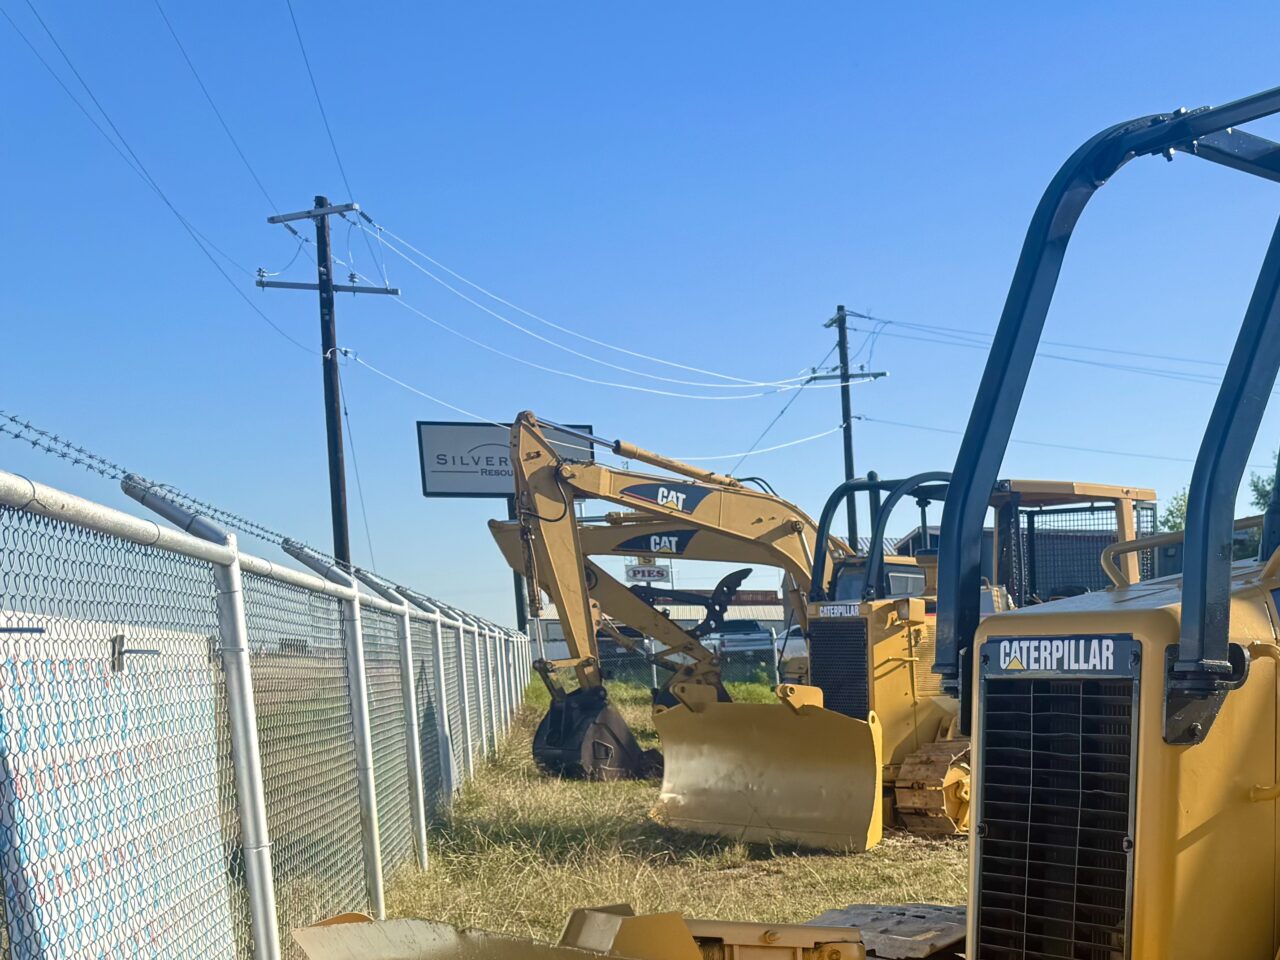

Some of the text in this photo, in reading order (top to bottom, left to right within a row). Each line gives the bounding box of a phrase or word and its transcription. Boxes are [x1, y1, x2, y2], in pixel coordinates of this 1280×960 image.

[436, 453, 509, 467] SILVER
[480, 468, 514, 477] RESOU
[657, 486, 687, 512] CAT
[650, 535, 679, 553] CAT
[632, 569, 665, 578] PIES
[820, 604, 860, 618] CATERPILLAR
[1000, 638, 1115, 670] CATERPILLAR
